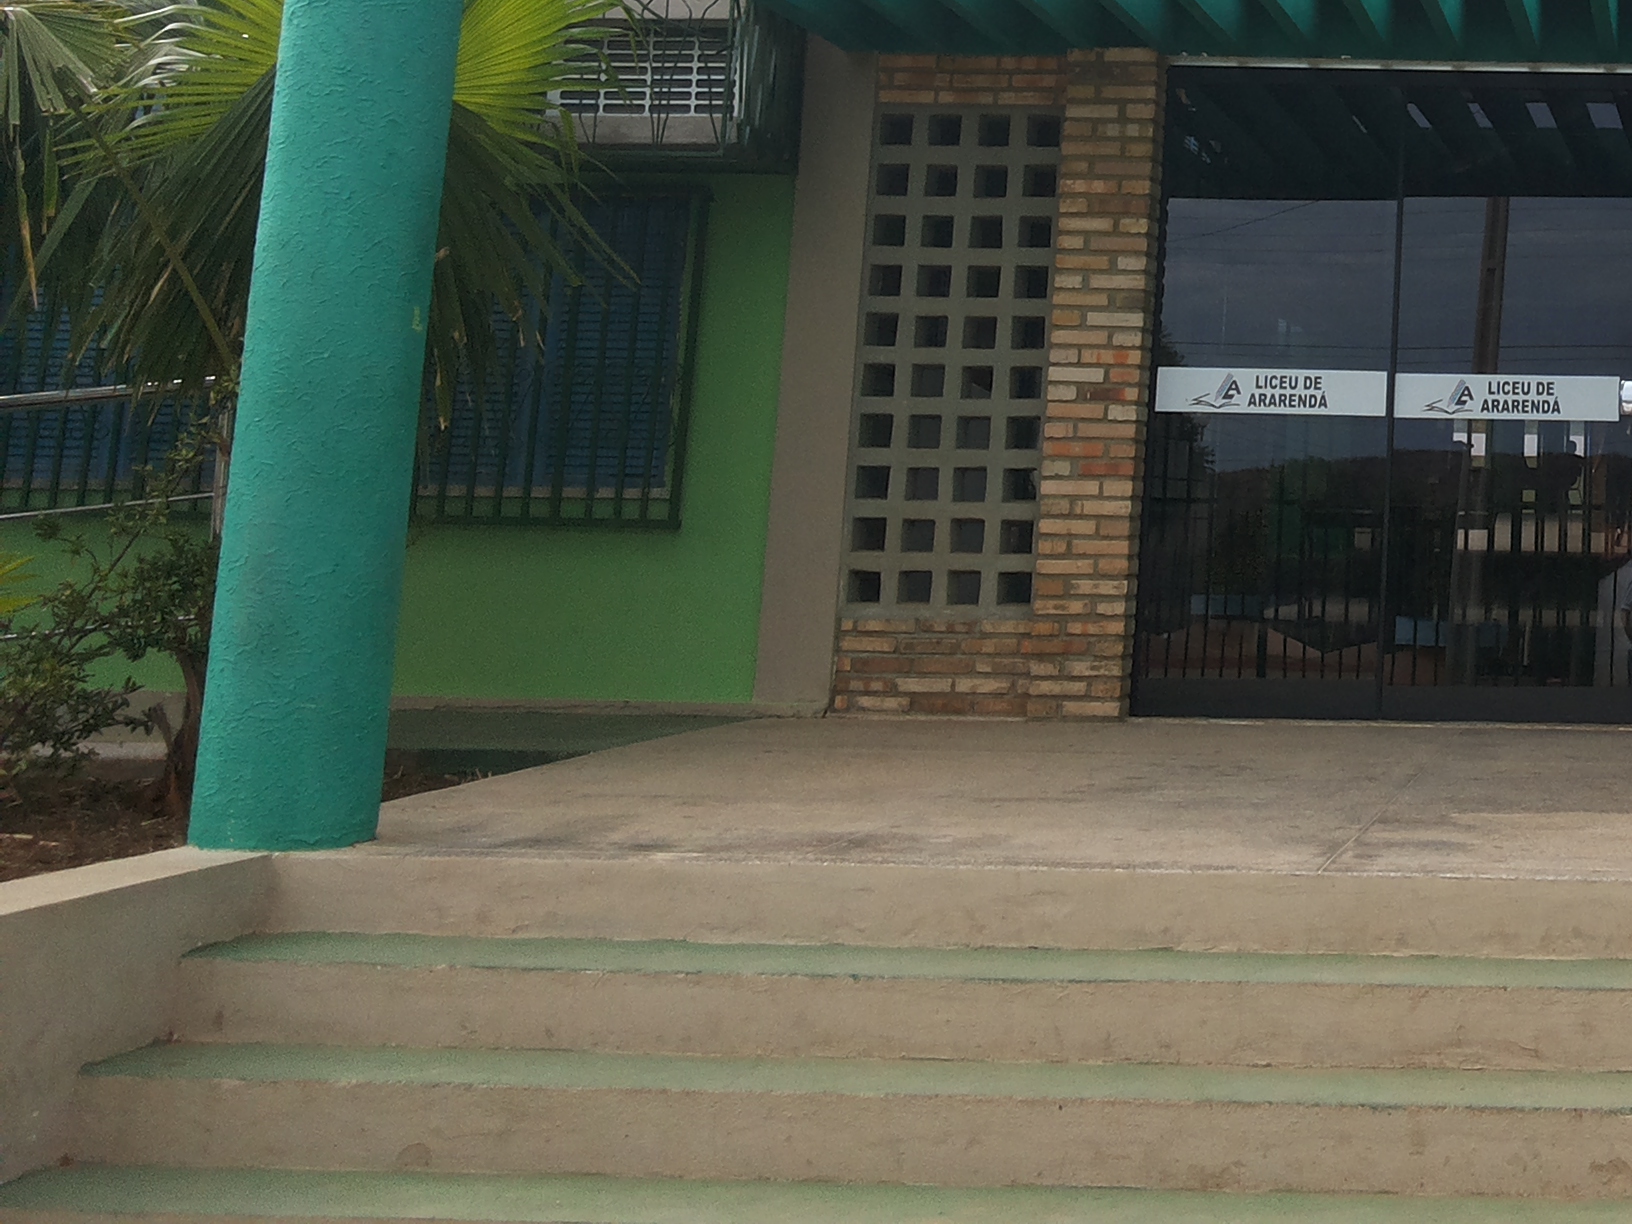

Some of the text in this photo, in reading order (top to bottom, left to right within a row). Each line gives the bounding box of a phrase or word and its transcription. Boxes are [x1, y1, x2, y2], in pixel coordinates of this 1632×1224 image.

[1255, 375, 1322, 390] LICEU DE
[1488, 381, 1554, 396] LICEU DE
[1247, 390, 1328, 409] ARARENDÁ
[1480, 397, 1561, 415] ARARENDÁ
